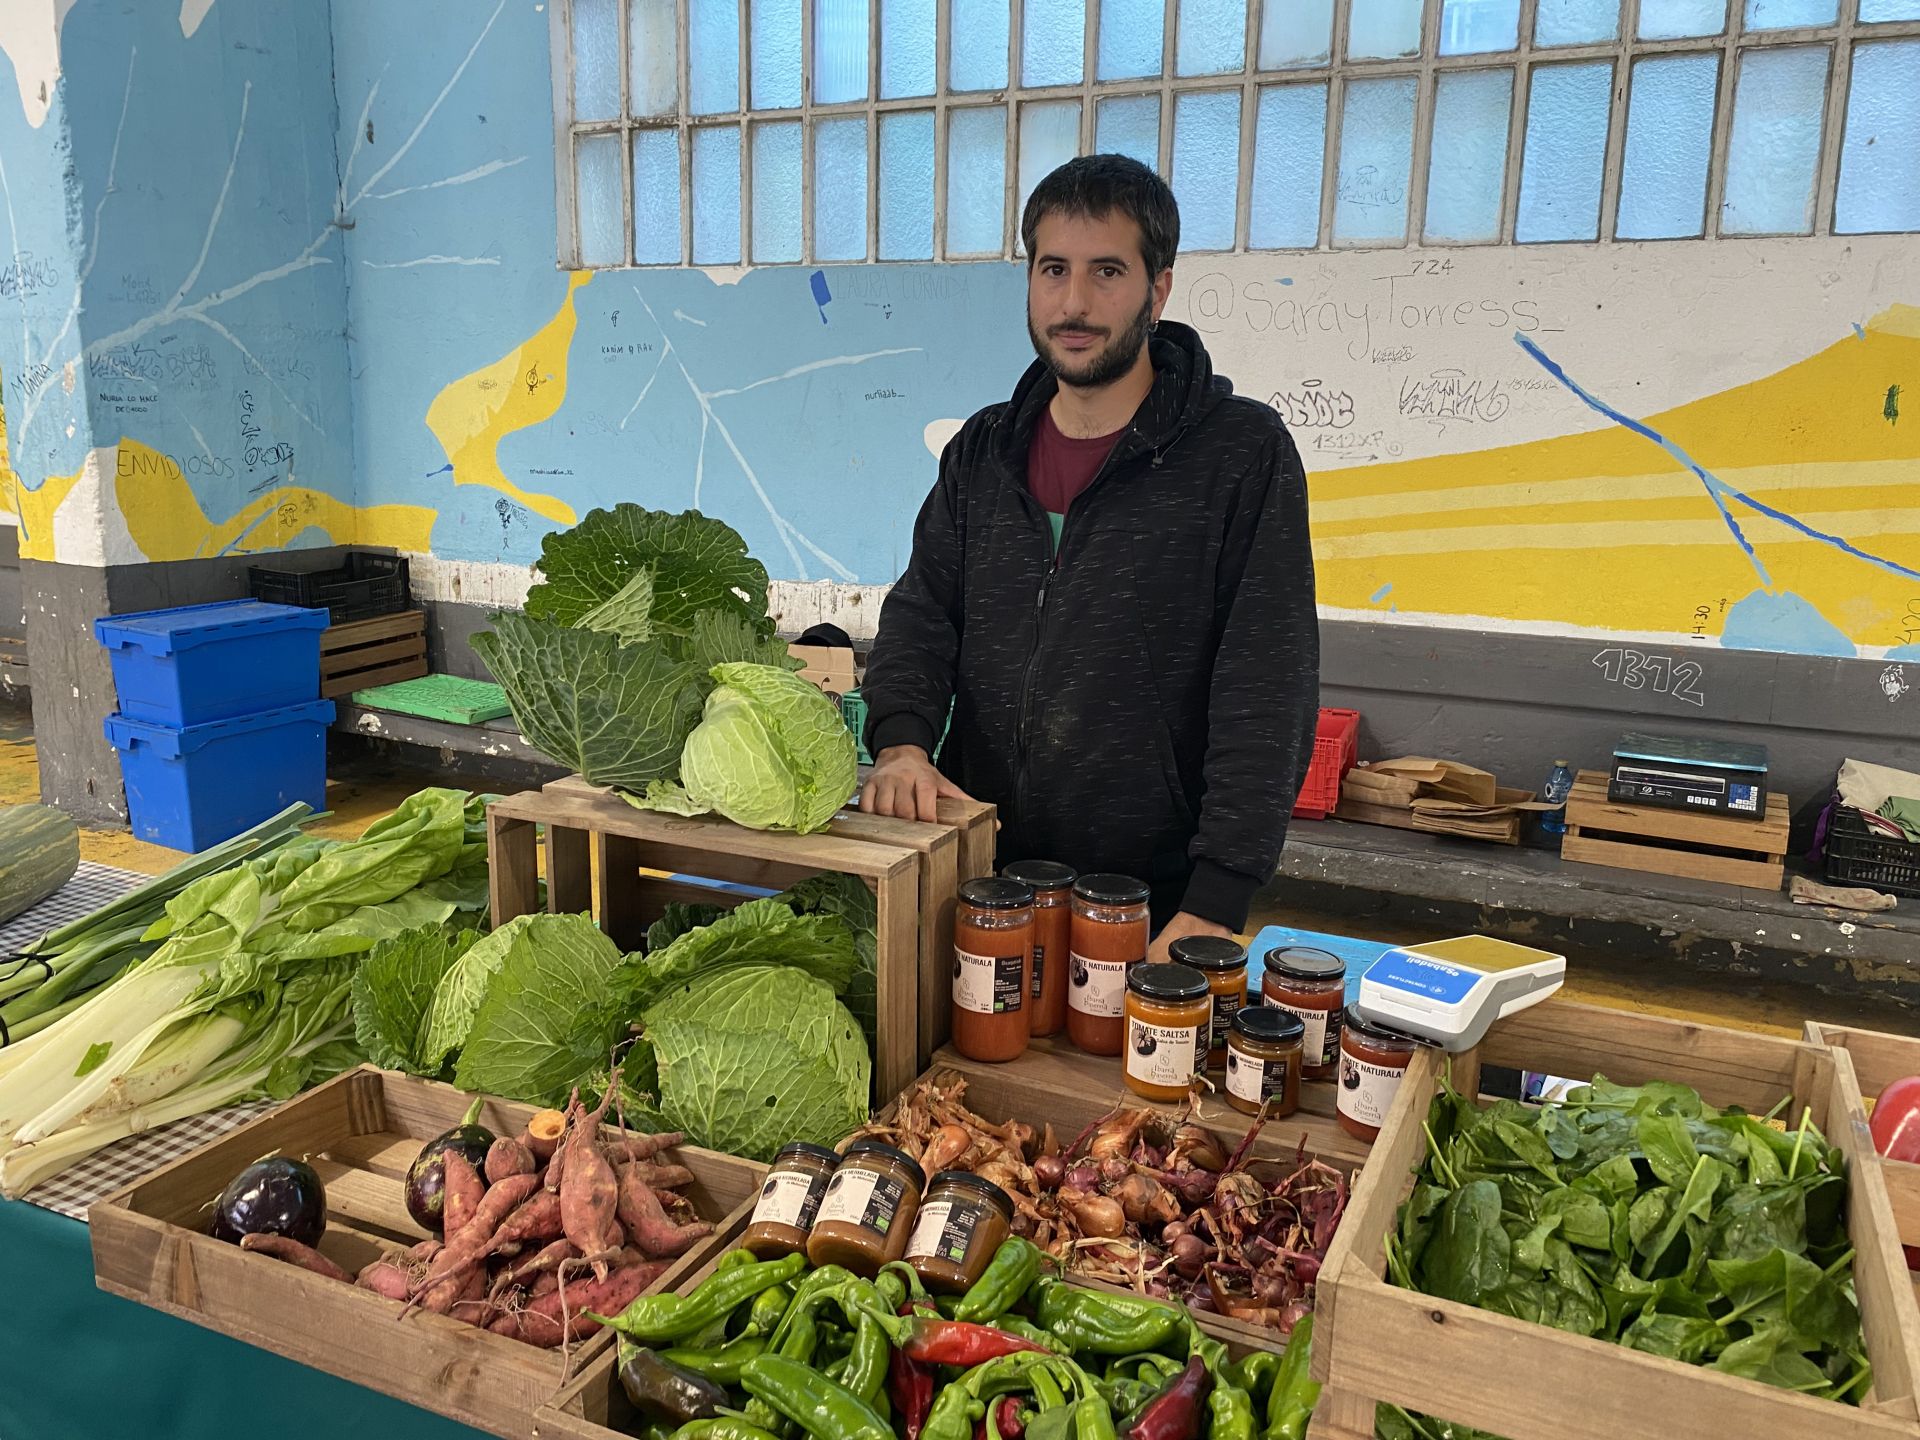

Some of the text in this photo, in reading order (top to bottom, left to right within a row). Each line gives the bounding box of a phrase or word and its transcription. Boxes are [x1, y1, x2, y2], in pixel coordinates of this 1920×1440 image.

[116, 449, 235, 480] ENVIDIOSOS
[1592, 648, 1704, 707] 1312
[961, 954, 992, 967] NATURALA
[1088, 961, 1123, 972] NATURALA
[1131, 1021, 1190, 1039] TOMATE SALTSA
[1360, 1064, 1402, 1079] NATURALA
